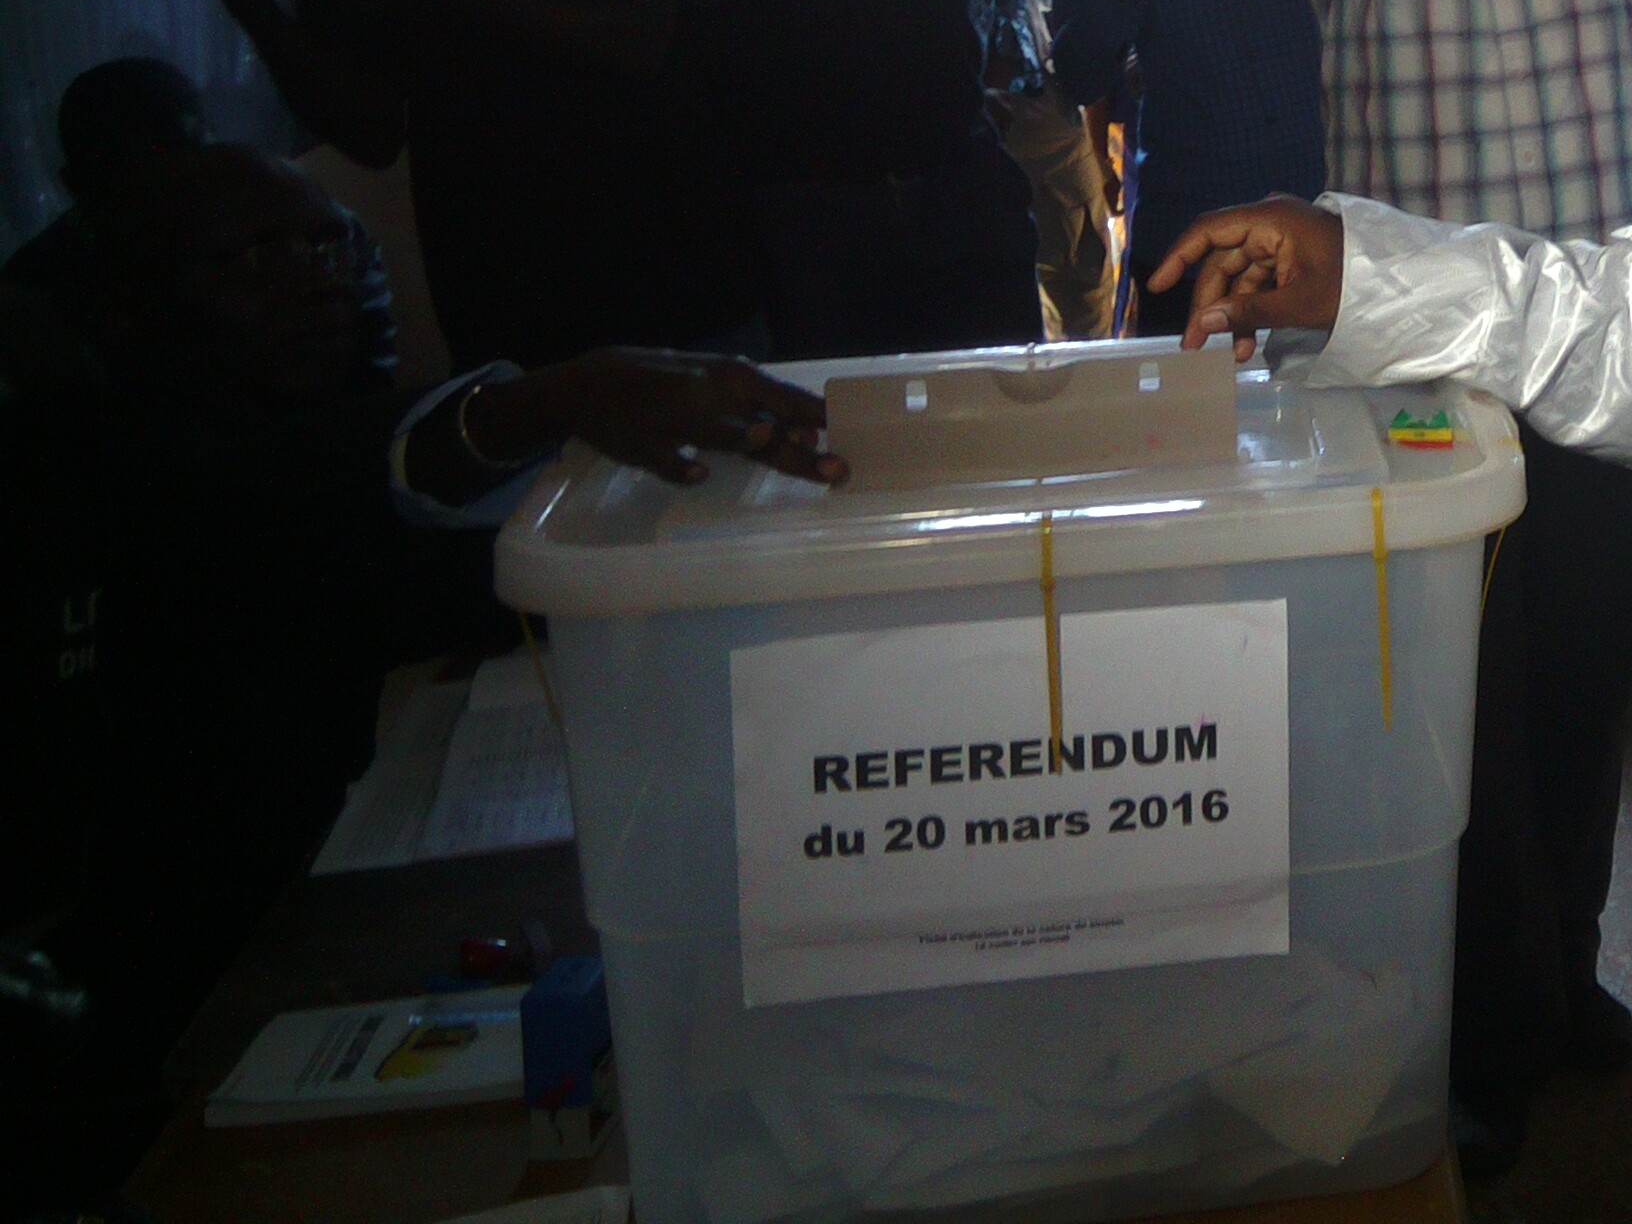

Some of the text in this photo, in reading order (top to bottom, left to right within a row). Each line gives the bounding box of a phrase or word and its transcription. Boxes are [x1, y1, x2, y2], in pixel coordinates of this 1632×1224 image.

[813, 722, 1218, 794] REFERENDUM
[803, 788, 1230, 859] du 20 mars 2016
